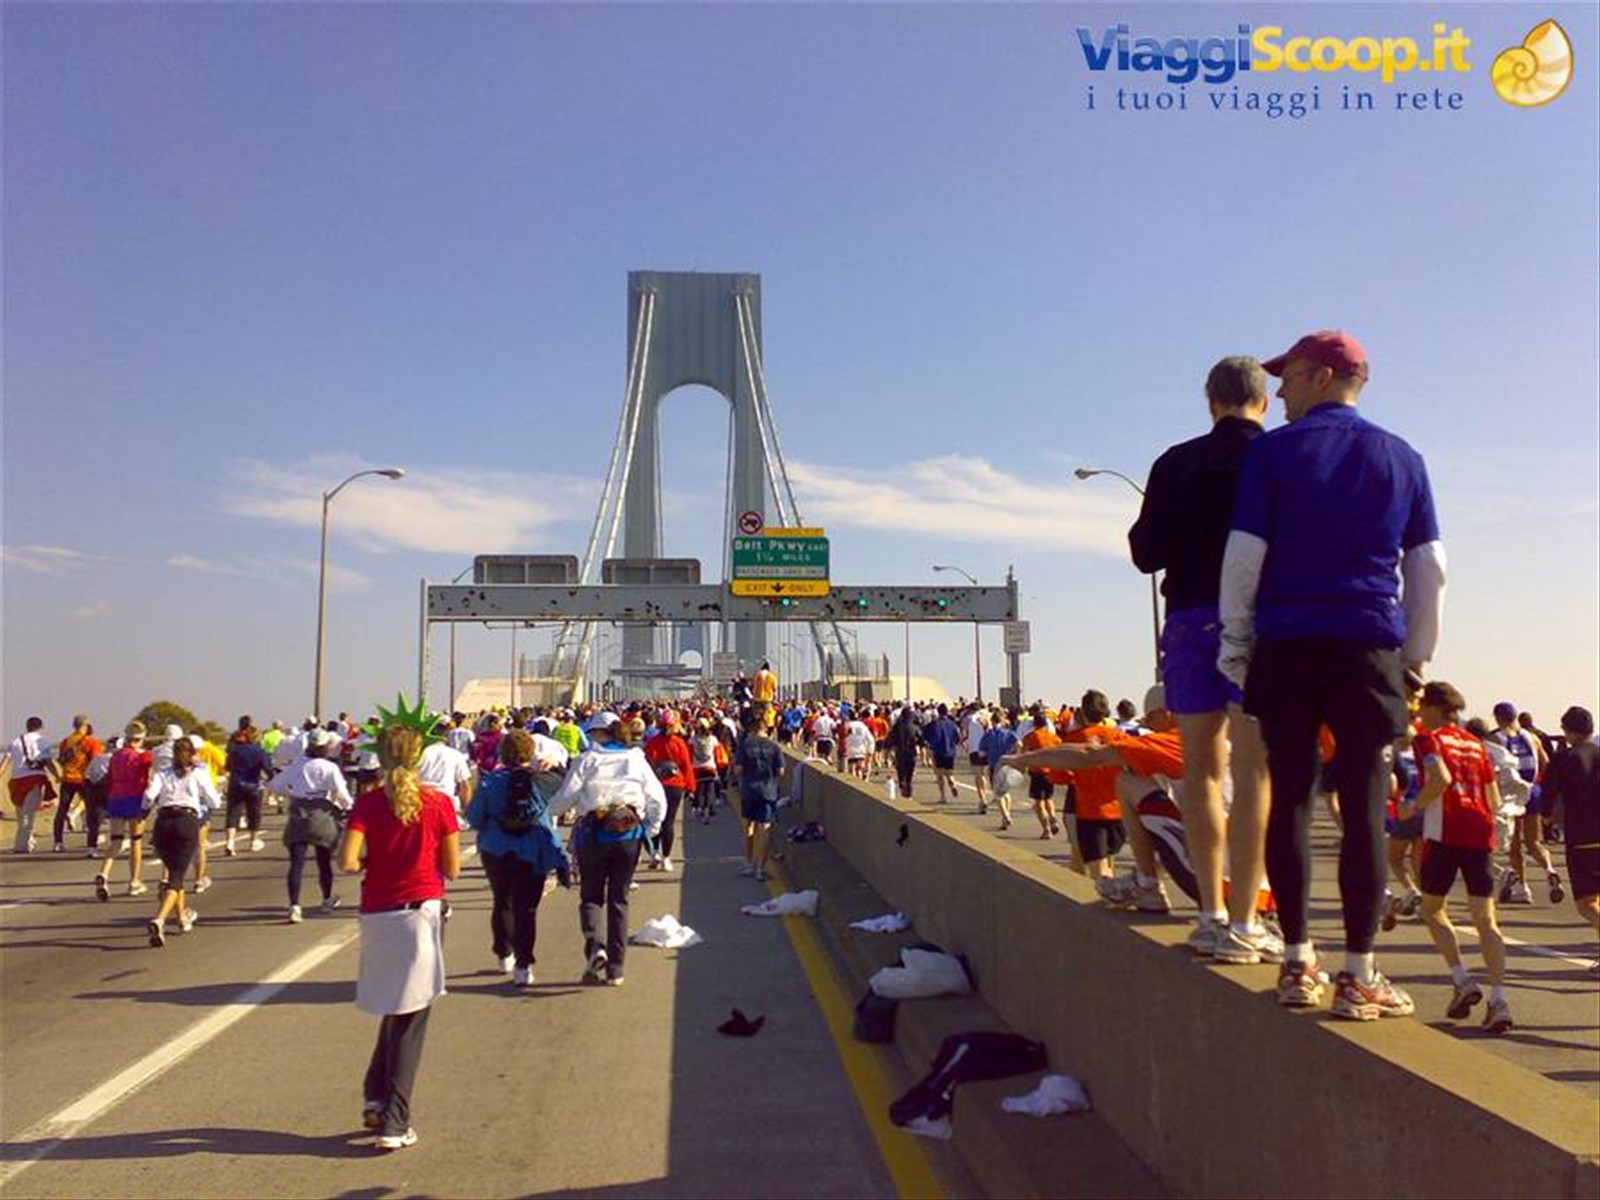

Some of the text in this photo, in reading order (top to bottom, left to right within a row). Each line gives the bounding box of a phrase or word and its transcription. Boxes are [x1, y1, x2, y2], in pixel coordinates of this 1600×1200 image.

[735, 540, 762, 550] Belt
[745, 583, 814, 592] EXIT ONLY
